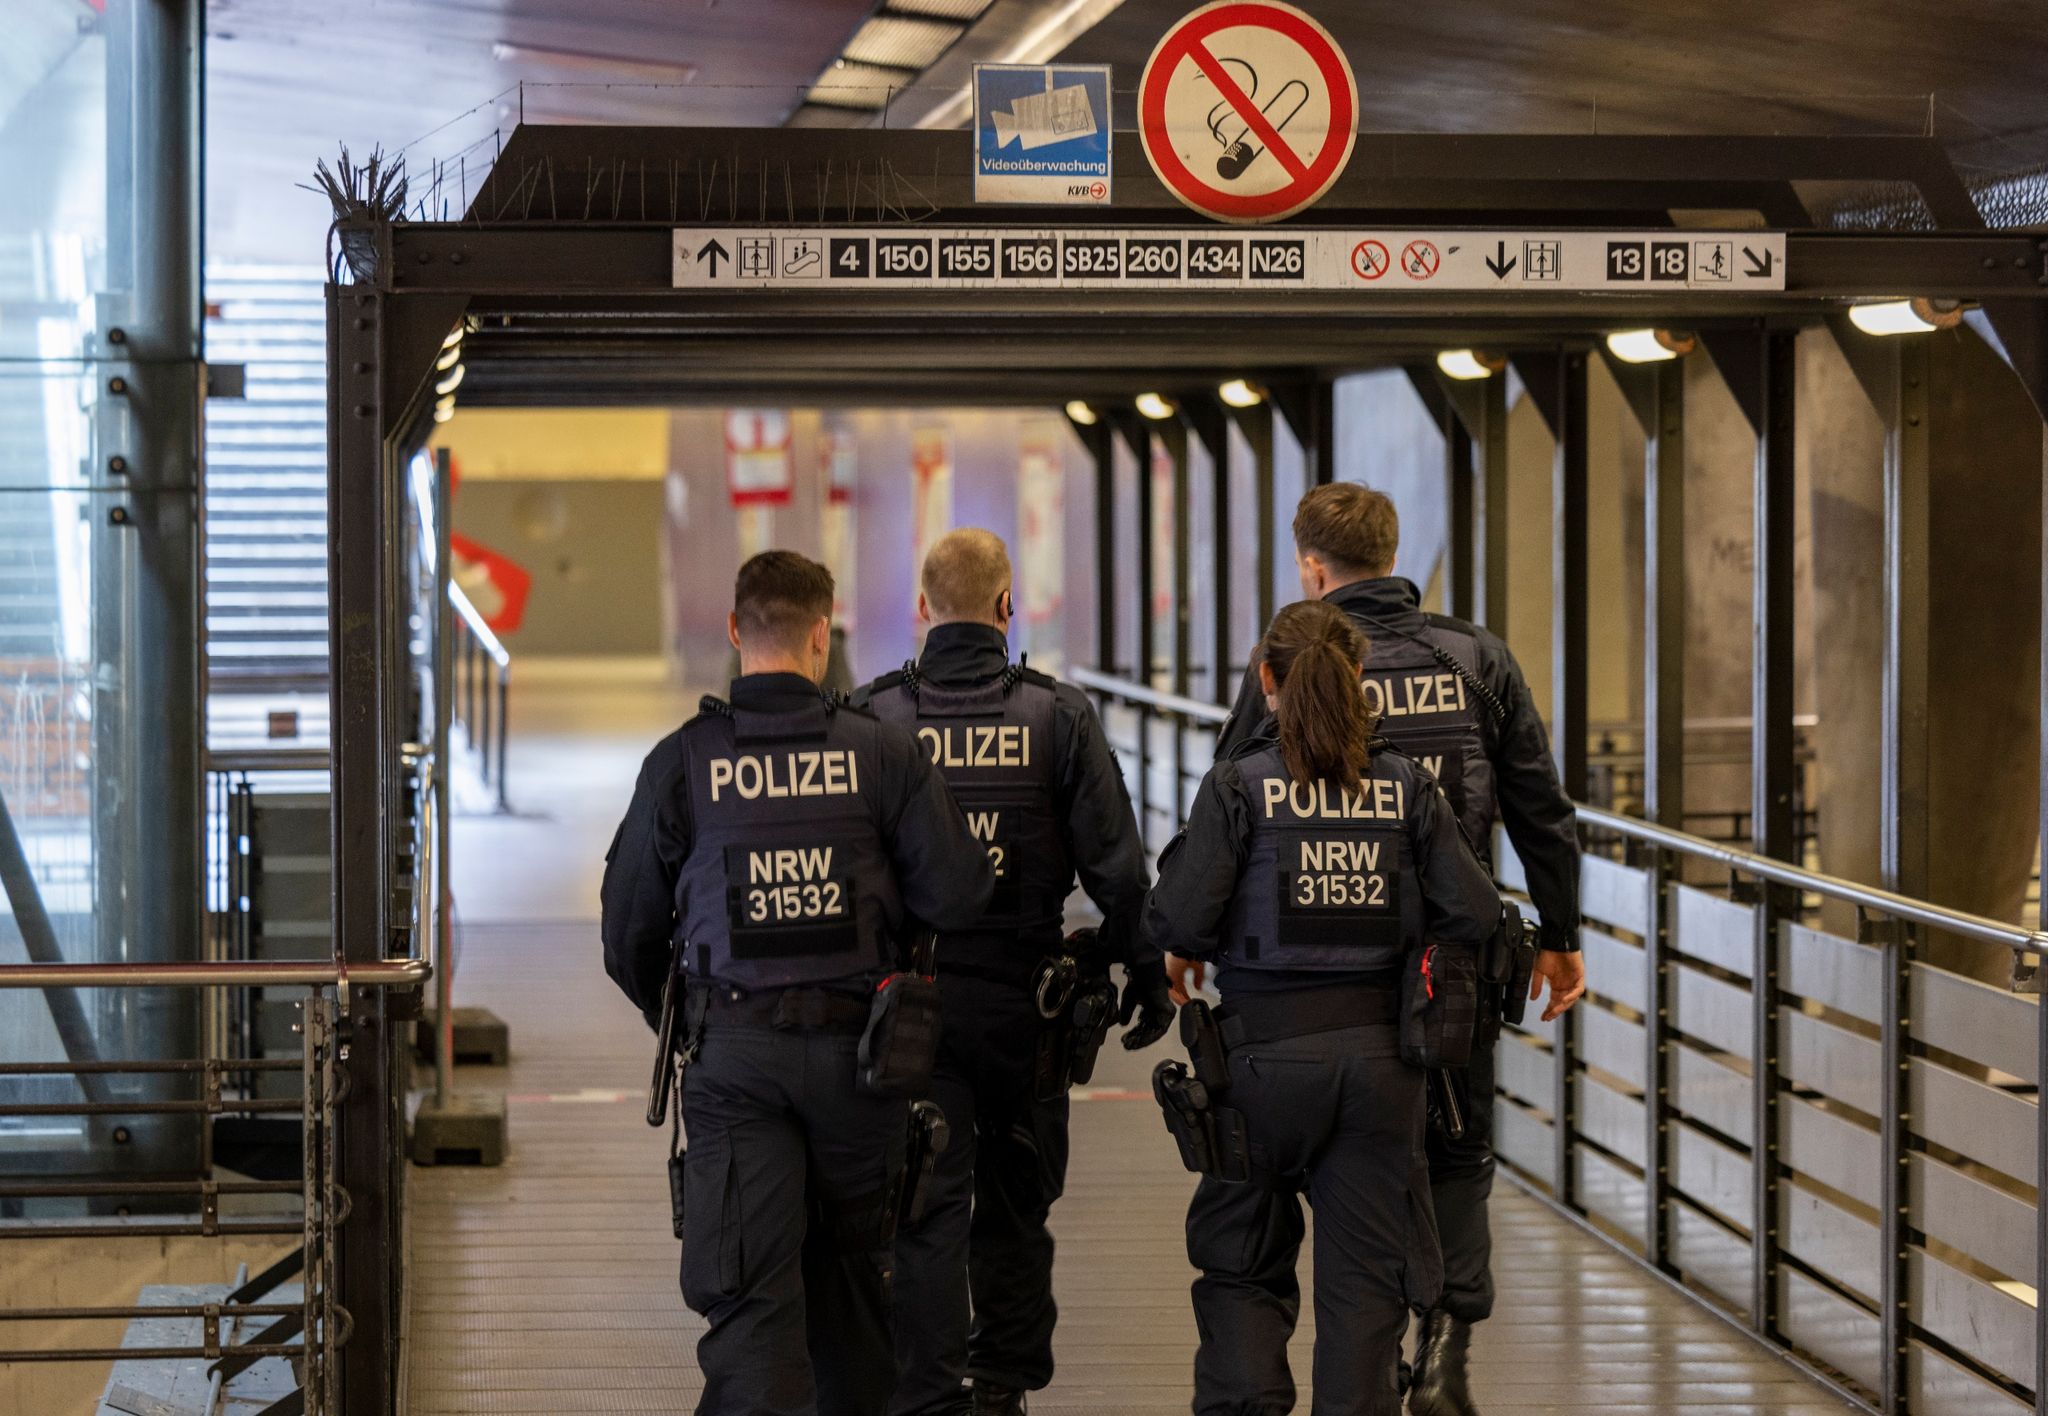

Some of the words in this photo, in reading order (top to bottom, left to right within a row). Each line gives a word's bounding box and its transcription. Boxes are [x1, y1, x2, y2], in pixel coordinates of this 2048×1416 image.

[982, 158, 1106, 174] Videoüberwachung
[1068, 185, 1090, 196] KVB
[838, 245, 860, 271] 4
[878, 245, 929, 271] 150
[941, 245, 992, 271] 155
[1005, 245, 1054, 272] 156
[1064, 246, 1120, 272] SB25
[1128, 246, 1179, 272] 260
[1189, 246, 1241, 272] 434
[1251, 246, 1302, 273] N26
[1610, 248, 1642, 274] 13
[1654, 248, 1686, 274] 18
[1360, 673, 1467, 718] OLIZEI
[917, 726, 1030, 767] OLIZEI
[710, 750, 858, 802] POLIZEI
[1263, 778, 1404, 820] POLIZEI
[750, 847, 832, 884] NRW
[1301, 841, 1380, 871] NRW
[748, 882, 842, 922] 31532
[1297, 875, 1385, 905] 31532
